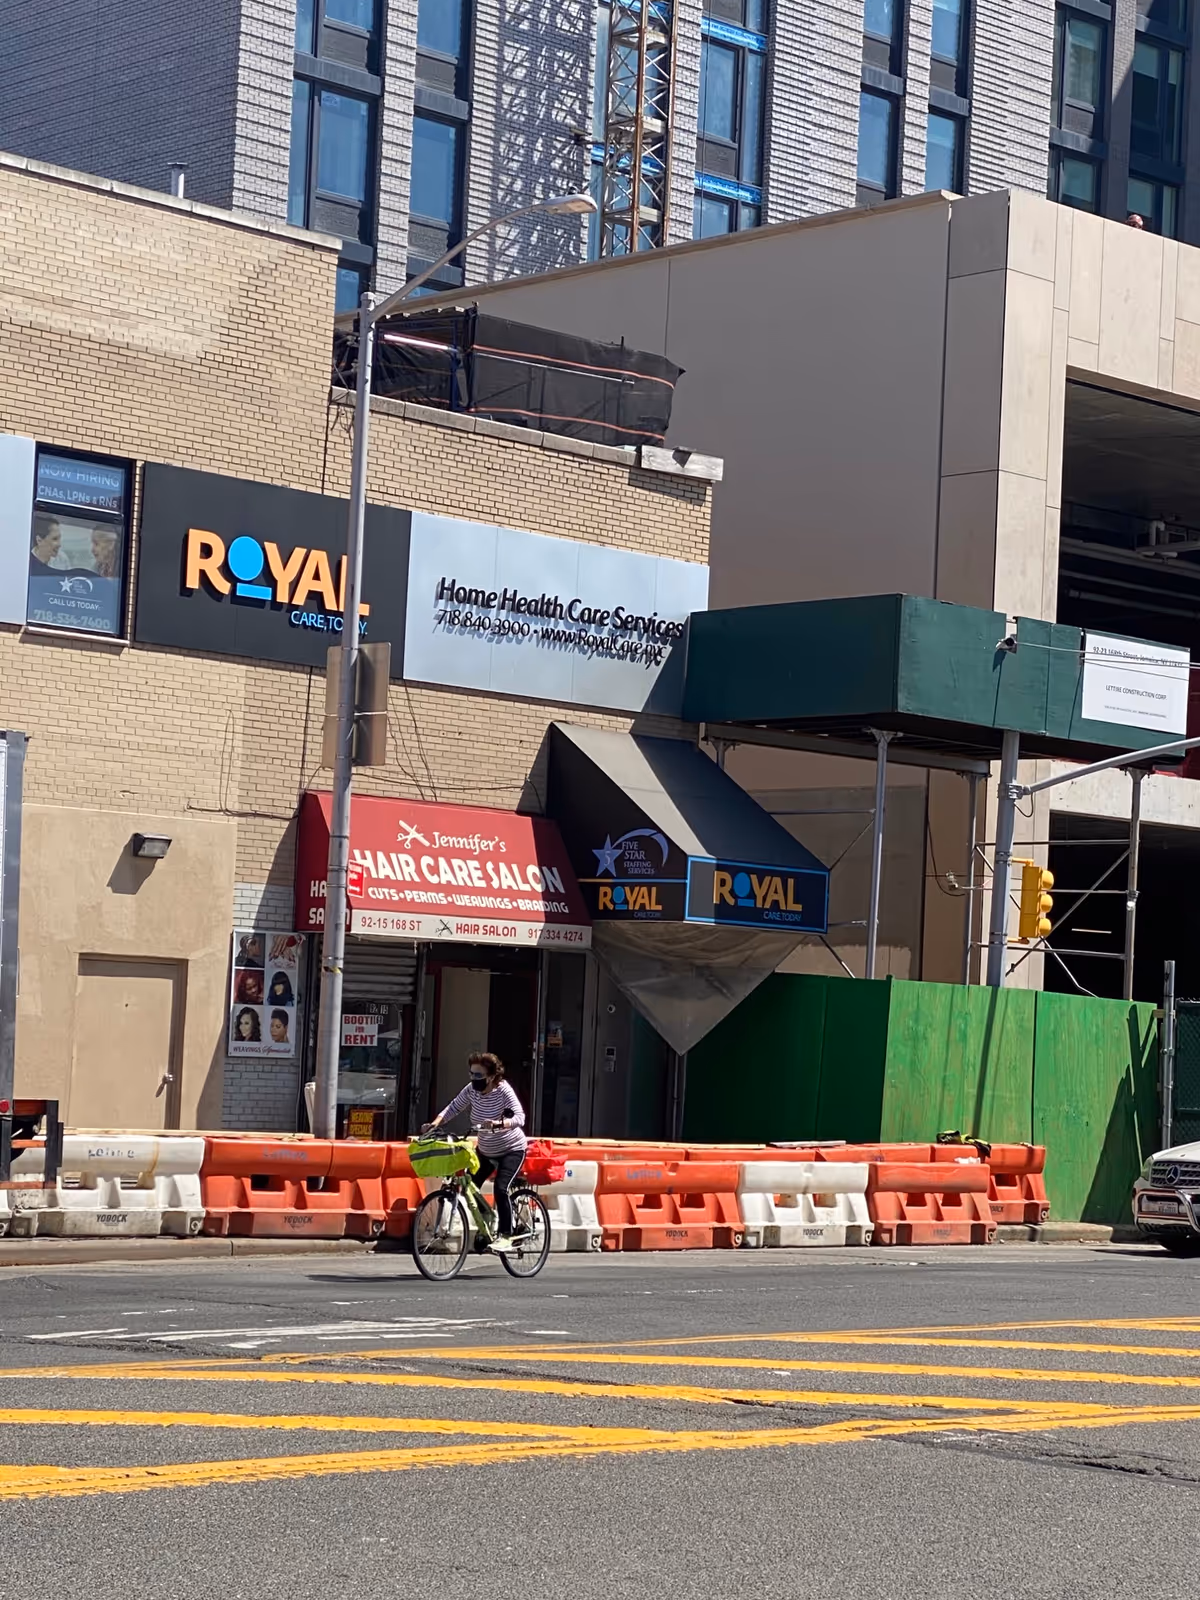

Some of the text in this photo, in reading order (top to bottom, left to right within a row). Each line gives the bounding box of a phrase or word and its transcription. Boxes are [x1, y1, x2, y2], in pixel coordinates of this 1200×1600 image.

[40, 464, 119, 488] NOW HIRING
[67, 489, 91, 504] LPNs
[99, 496, 118, 508] RNs
[186, 528, 370, 616] ROYAL
[48, 597, 65, 606] CALL
[438, 577, 685, 640] Home Health Care Services
[437, 609, 531, 637] 718.840.3900
[1122, 687, 1155, 698] CONSTRUCTION
[431, 831, 507, 855] Jennifer's
[622, 841, 639, 850] FIVE
[624, 850, 646, 860] STAR
[353, 849, 421, 882] HAIR
[420, 855, 487, 888] CARE
[485, 861, 565, 893] SALON
[367, 887, 400, 901] CUTS
[516, 898, 569, 914] BRAIDING
[598, 885, 663, 911] ROYAL
[713, 870, 803, 912] ROYAL
[361, 916, 422, 931] 92-15 168 ST
[455, 923, 480, 935] HAIR
[482, 925, 517, 938] SALON
[563, 930, 583, 942] 4274
[344, 1034, 376, 1045] RENT
